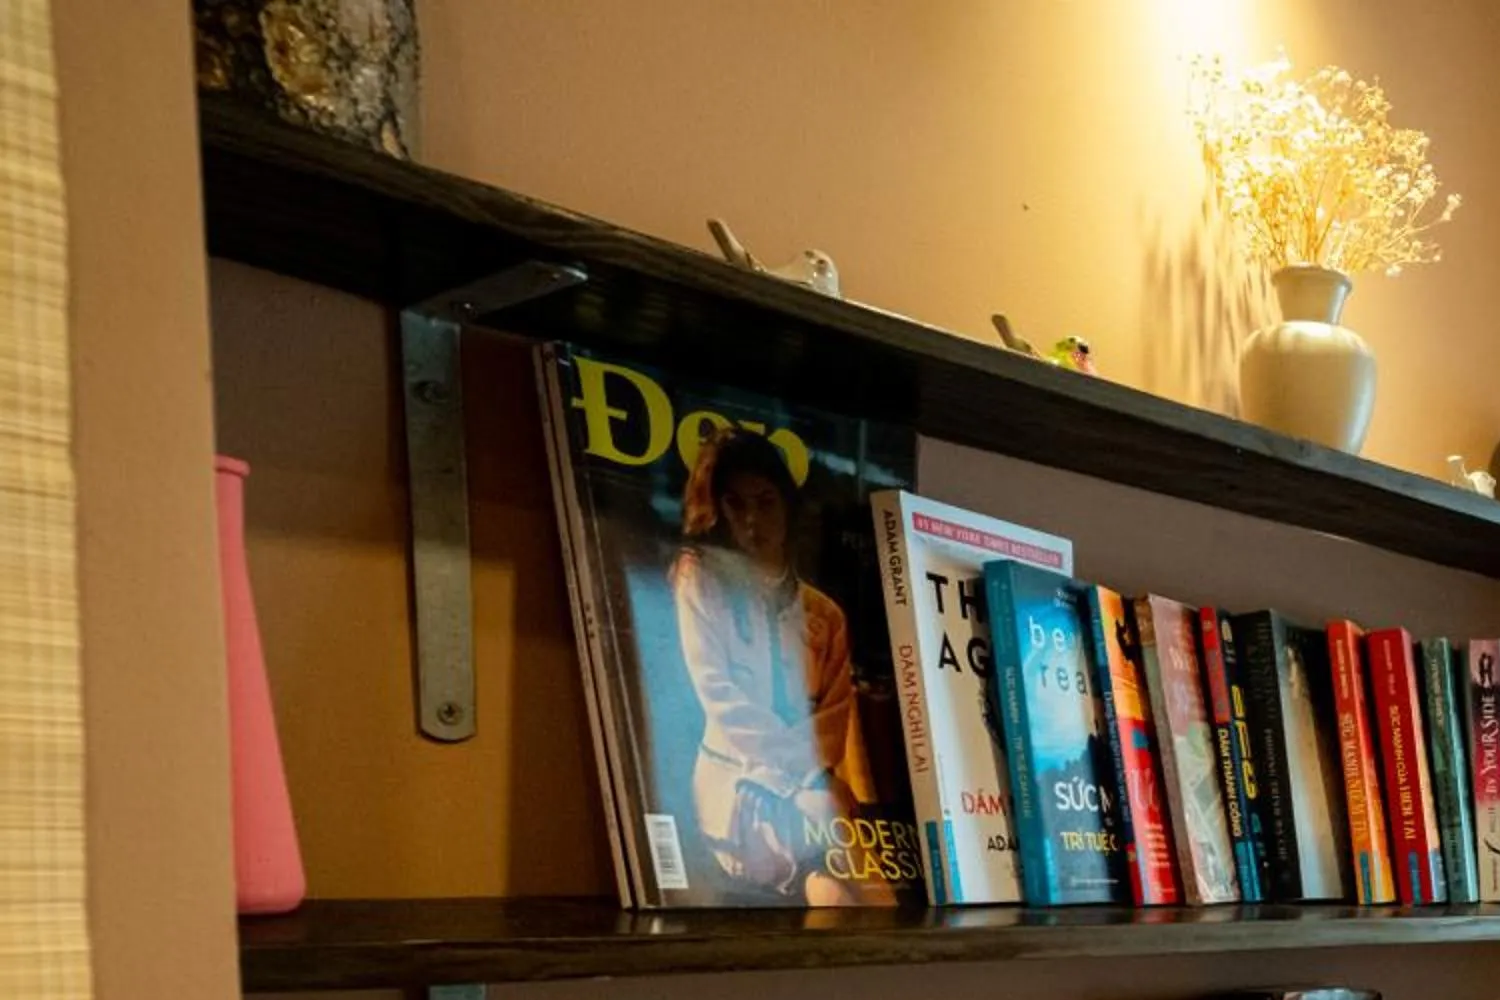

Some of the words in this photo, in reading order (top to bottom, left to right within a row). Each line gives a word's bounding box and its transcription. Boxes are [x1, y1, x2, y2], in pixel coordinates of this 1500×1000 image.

[883, 510, 900, 553] ADAM
[889, 554, 908, 606] GRANT
[1481, 695, 1499, 729] SIDE
[1054, 775, 1099, 812] SỨC
